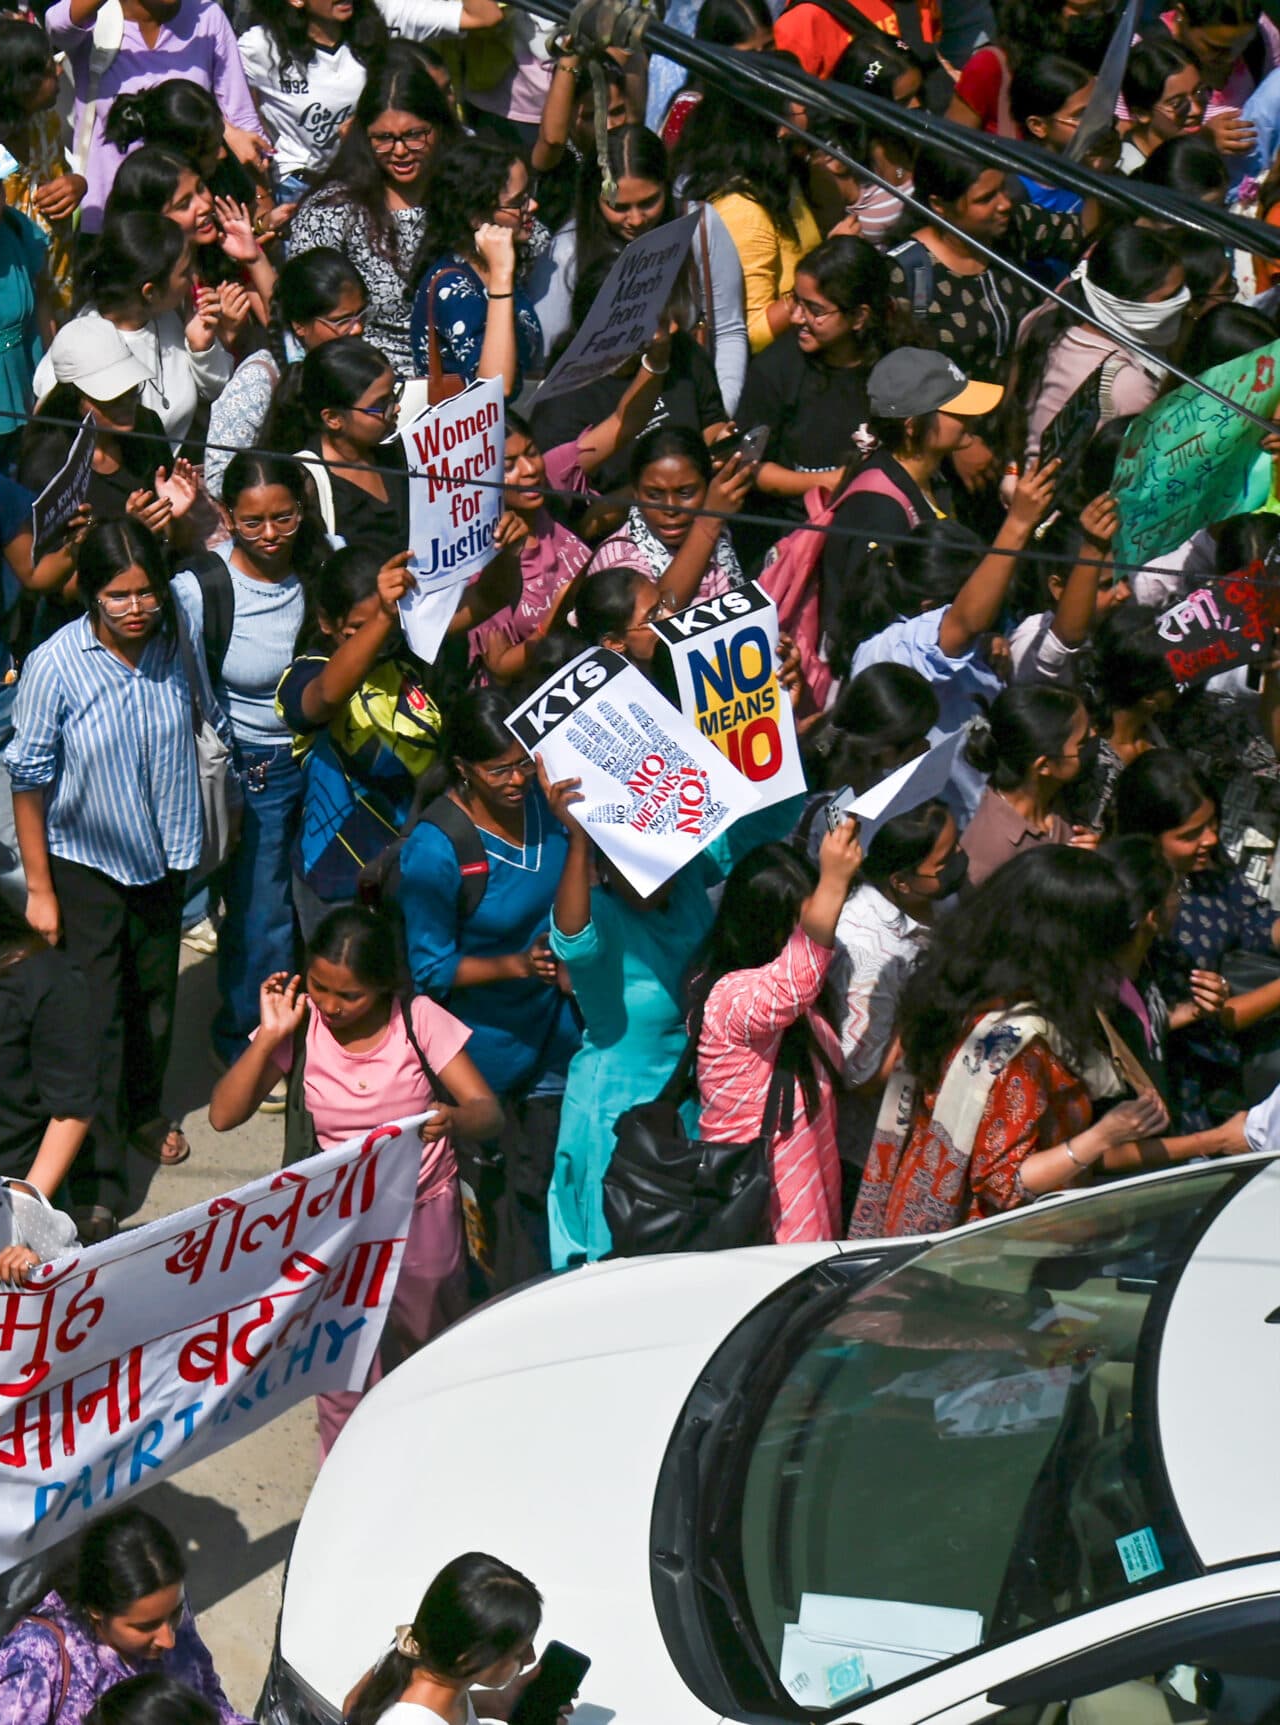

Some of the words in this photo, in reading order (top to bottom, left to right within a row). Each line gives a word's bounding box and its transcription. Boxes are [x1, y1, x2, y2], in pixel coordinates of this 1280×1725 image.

[619, 243, 681, 281] Women
[611, 268, 663, 309] March
[412, 402, 499, 465] Women
[426, 432, 497, 503] March
[449, 489, 484, 529] for
[669, 591, 752, 636] KYS
[687, 626, 772, 714] NO
[526, 660, 608, 735] KYS
[699, 687, 775, 736] MEANS
[601, 756, 617, 771] NO
[626, 754, 665, 796] NO
[630, 770, 681, 832] MEANS
[648, 814, 665, 830] NO
[676, 767, 708, 835] NO!
